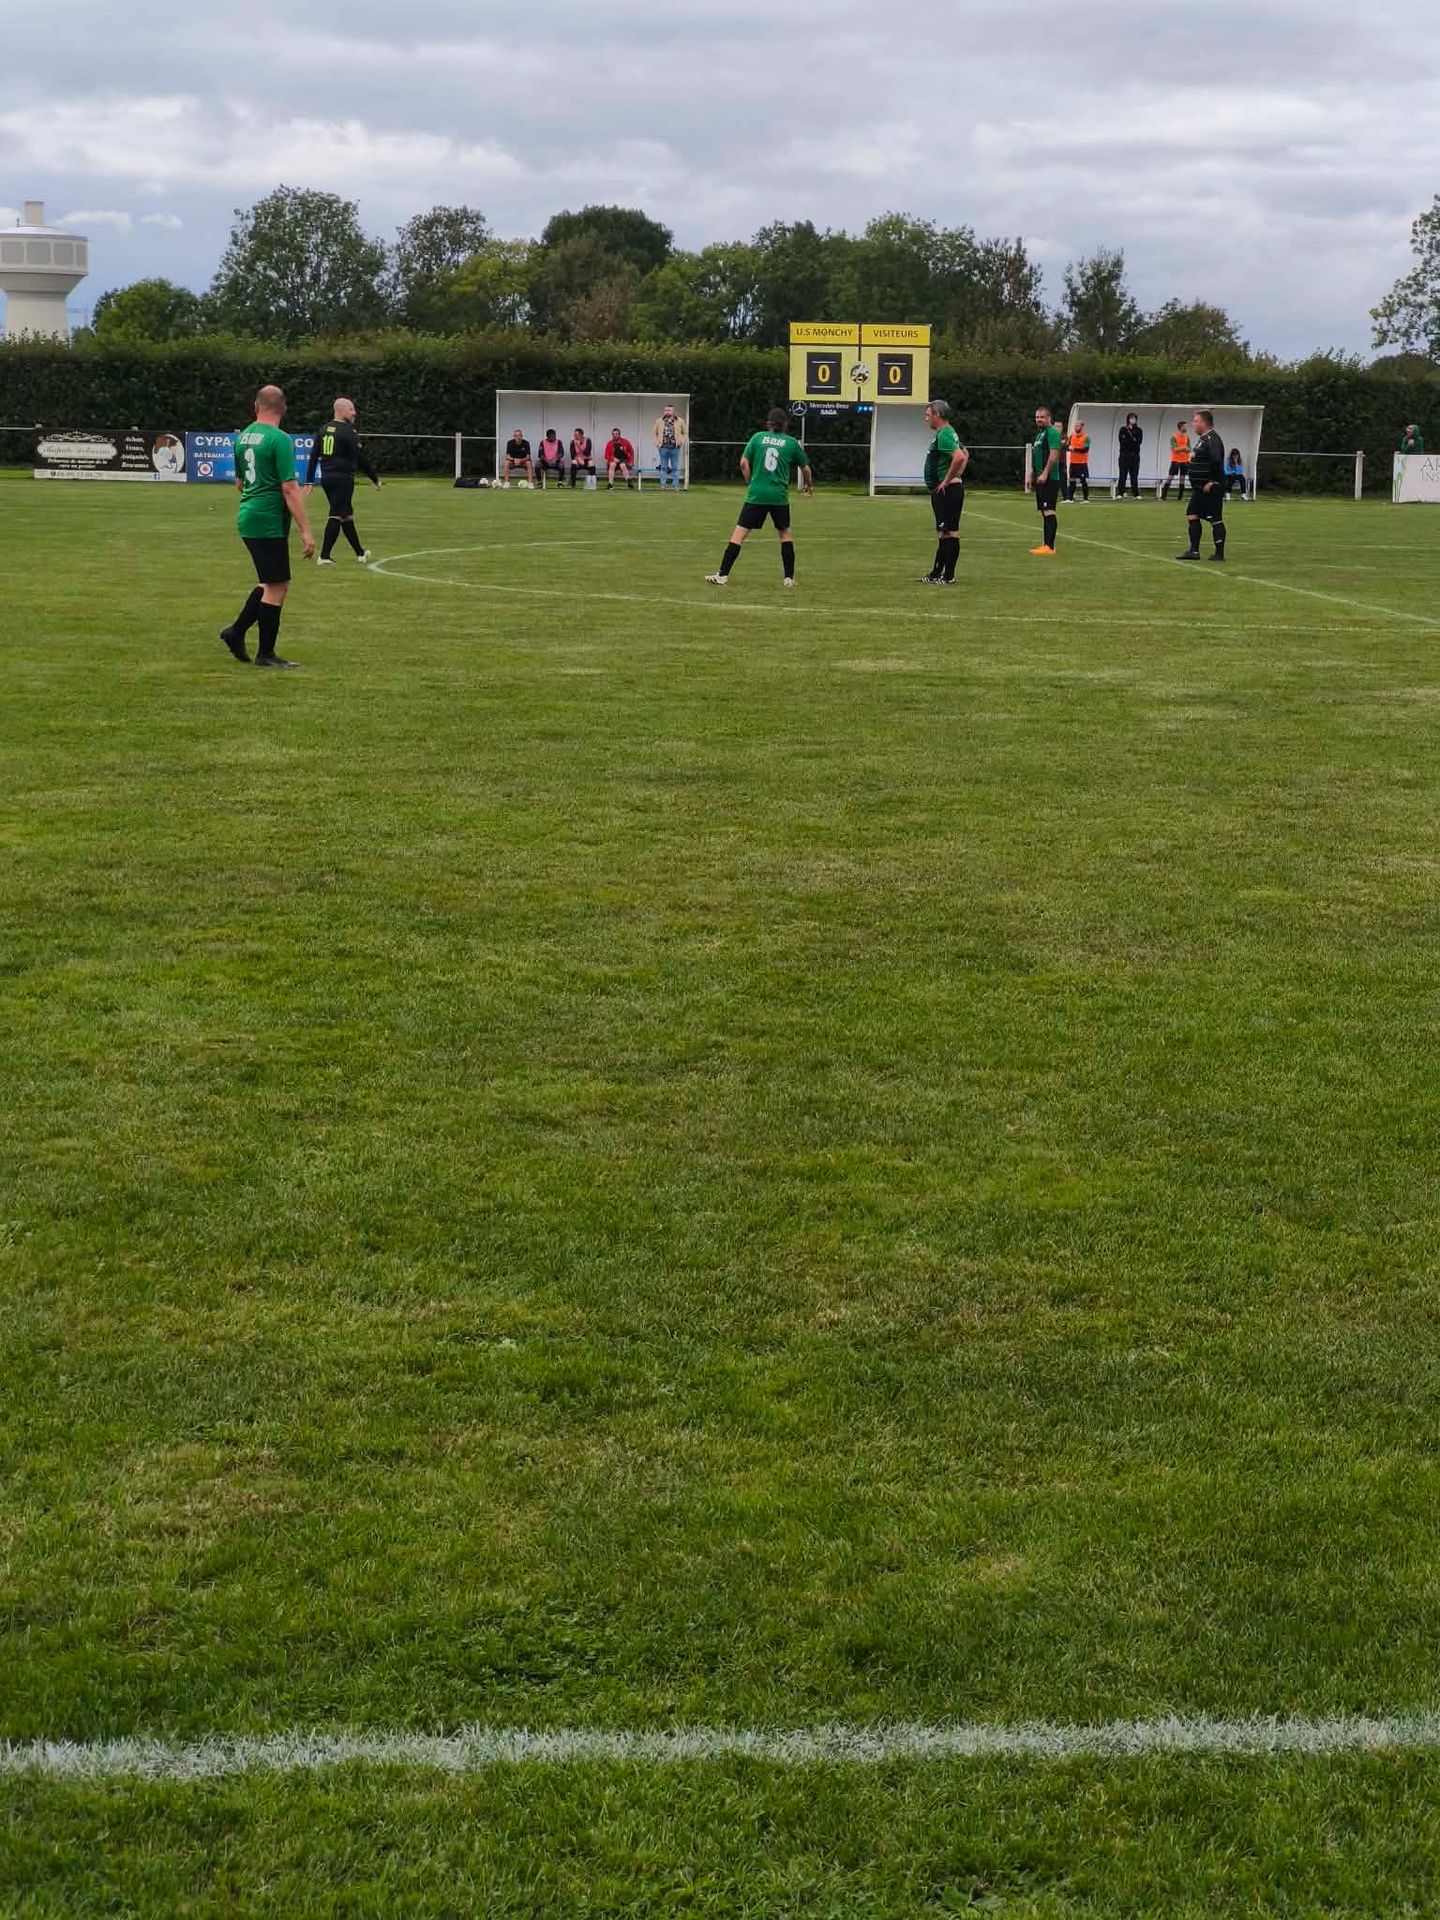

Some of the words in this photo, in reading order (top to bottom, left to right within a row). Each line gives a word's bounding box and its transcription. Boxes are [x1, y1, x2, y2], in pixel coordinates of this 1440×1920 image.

[812, 328, 853, 337] MONCHY
[873, 329, 919, 338] VISITEURS
[817, 364, 831, 383] 0
[888, 365, 902, 384] 0
[321, 434, 335, 456] 10
[244, 447, 256, 485] 3
[764, 447, 779, 472] 6
